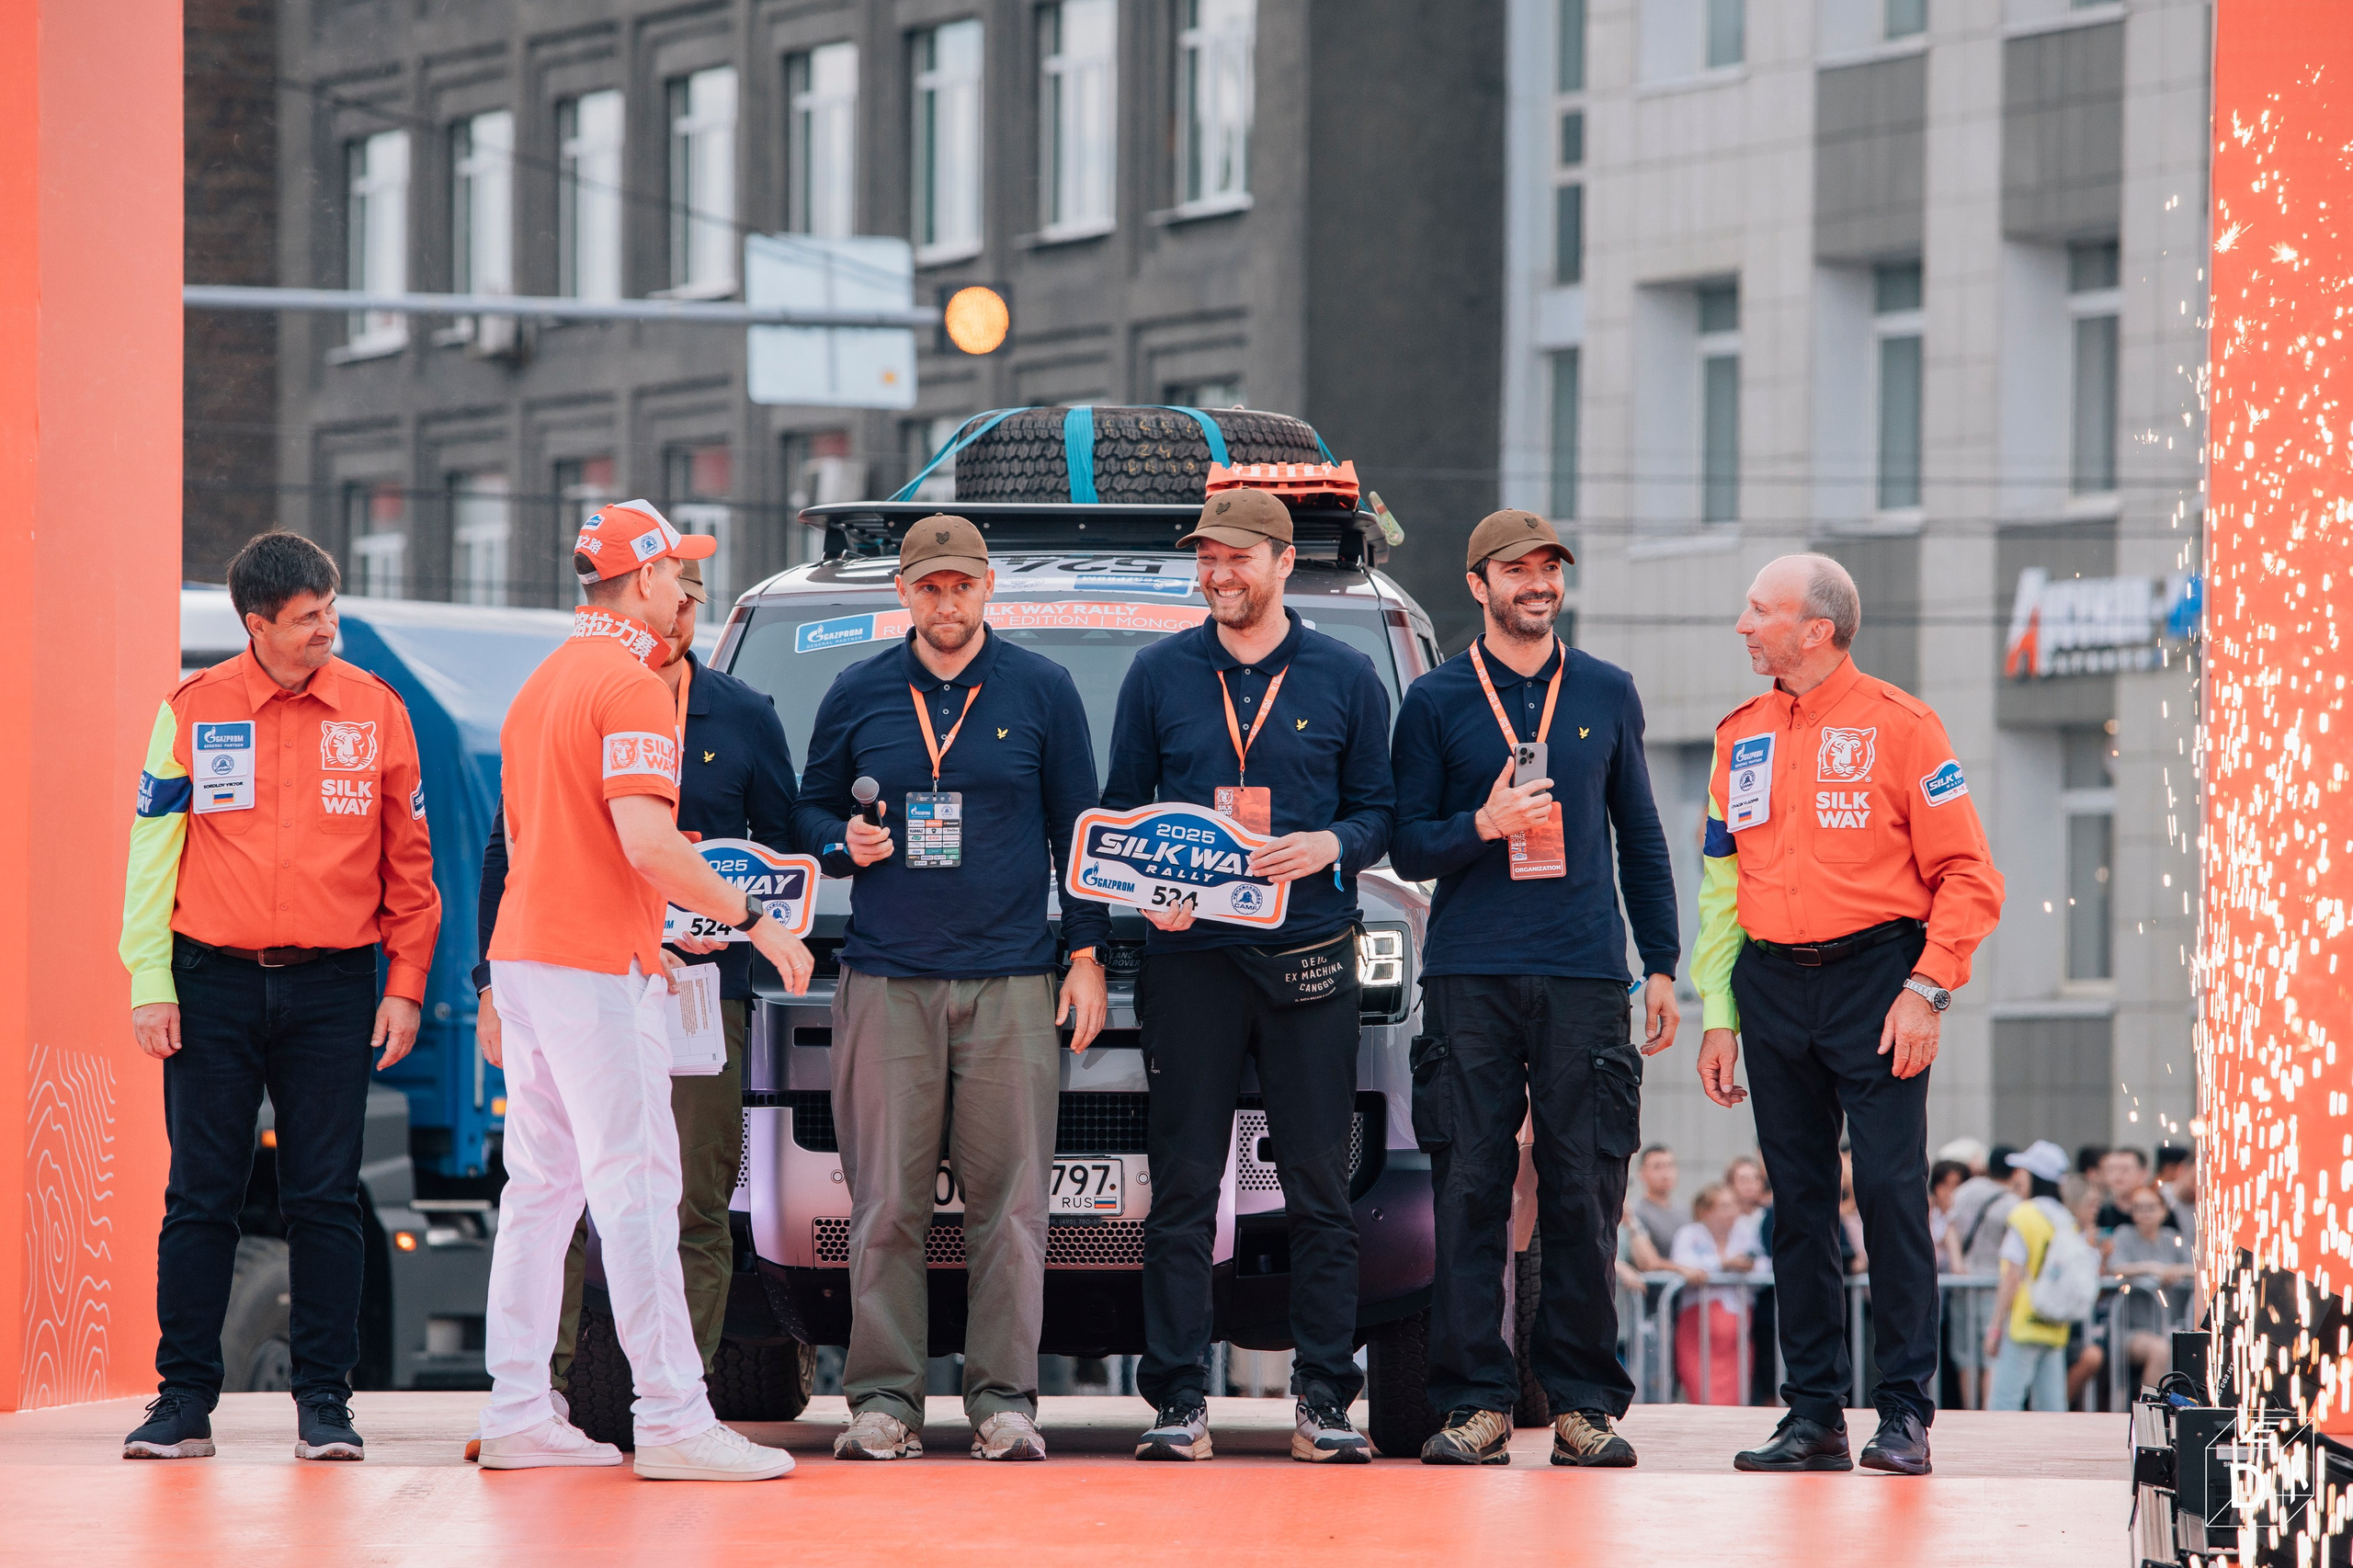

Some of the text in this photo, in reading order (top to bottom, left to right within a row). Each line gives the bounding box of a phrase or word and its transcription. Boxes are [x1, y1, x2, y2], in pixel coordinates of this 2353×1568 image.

[983, 605, 1139, 616] ILK WAY RALLY
[1009, 616, 1088, 626] EDITION
[1116, 617, 1199, 631] MONGO
[824, 628, 863, 641] GAZPROM
[806, 641, 833, 649] GENERAL
[321, 778, 373, 798] SILK
[1929, 774, 1954, 790] SILK
[321, 797, 373, 816] WAY
[1816, 791, 1870, 810] SILK
[1816, 811, 1870, 828] WAY
[1156, 824, 1216, 845] 2025
[1096, 832, 1188, 866] SILK
[710, 859, 748, 872] 025
[1145, 864, 1214, 882] RALLY
[1515, 865, 1561, 873] ORGANIZATION
[1097, 879, 1135, 893] GAZPROM
[689, 918, 733, 936] 524
[1286, 961, 1344, 983] EX MACHINA
[1299, 977, 1335, 992] CANGGU
[1062, 1197, 1093, 1209] RUS
[2220, 1374, 2231, 1390] CO2
